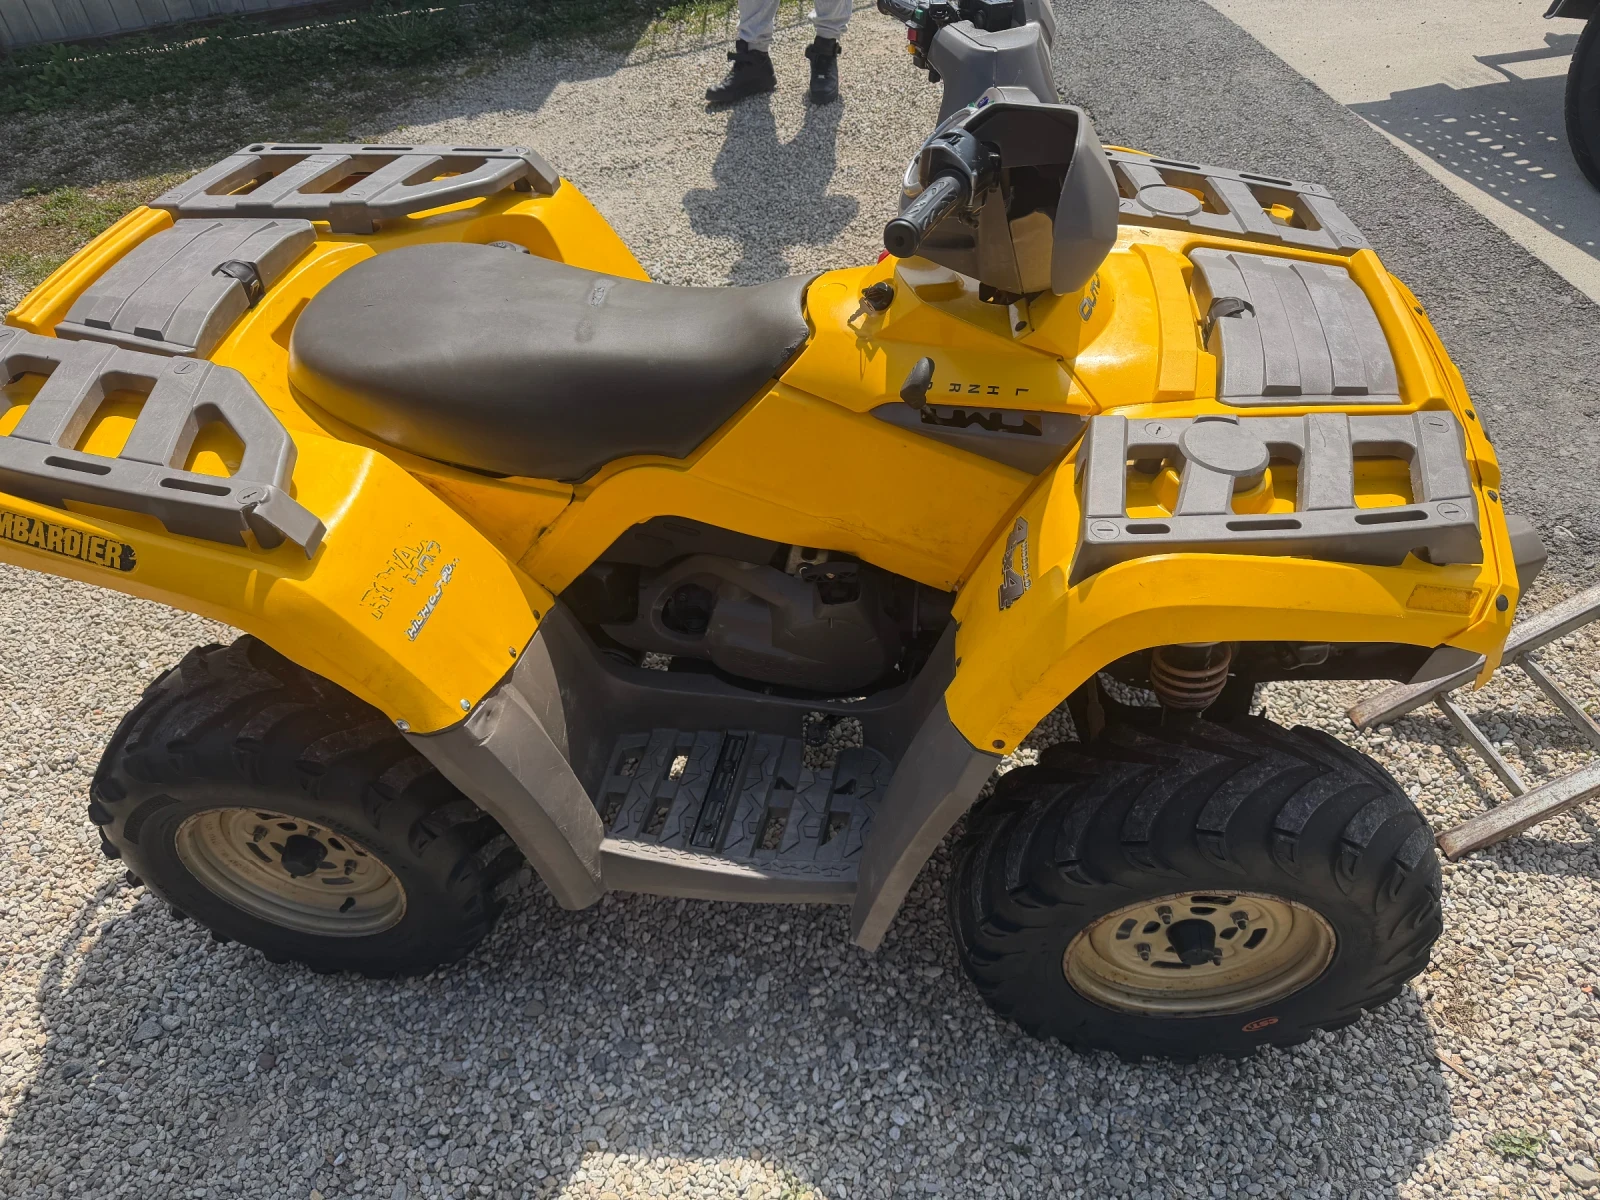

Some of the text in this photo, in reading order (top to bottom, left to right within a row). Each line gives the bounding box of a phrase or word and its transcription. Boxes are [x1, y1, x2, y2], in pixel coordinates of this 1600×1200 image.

[968, 384, 980, 394] N
[987, 386, 1000, 395] H
[1016, 388, 1029, 396] L
